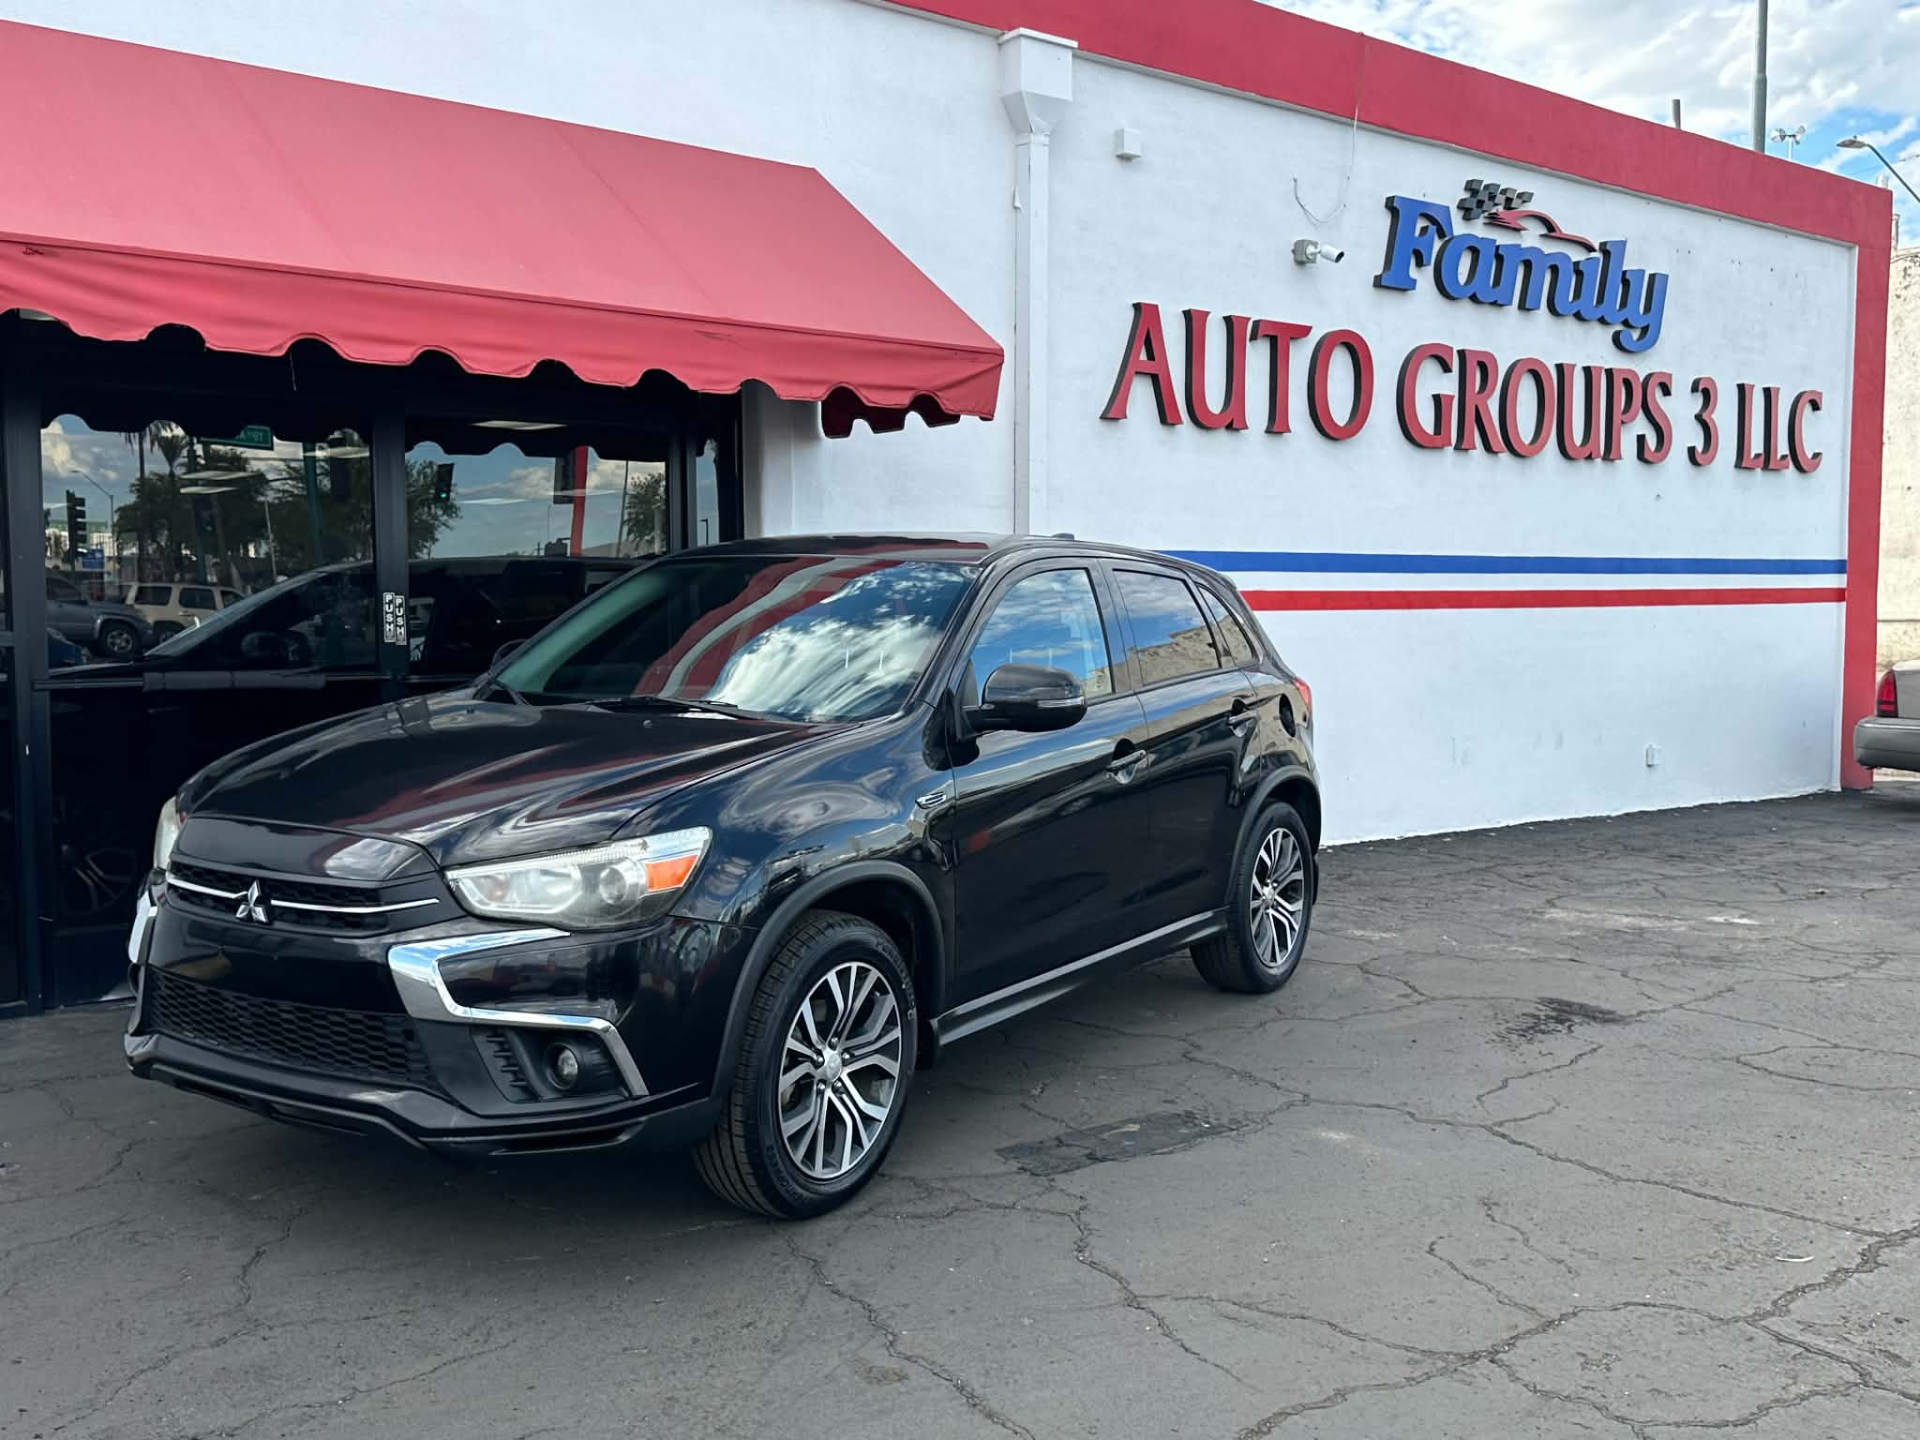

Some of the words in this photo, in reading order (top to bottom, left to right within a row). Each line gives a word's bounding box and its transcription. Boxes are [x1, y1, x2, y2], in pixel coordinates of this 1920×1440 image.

[1373, 195, 1669, 353] Family
[1100, 301, 1374, 440] AUTO
[1396, 342, 1672, 464] GROUPS
[1687, 376, 1719, 466] 3
[1735, 382, 1823, 473] LLC
[385, 594, 394, 631] PUSH
[395, 598, 404, 635] PUSH
